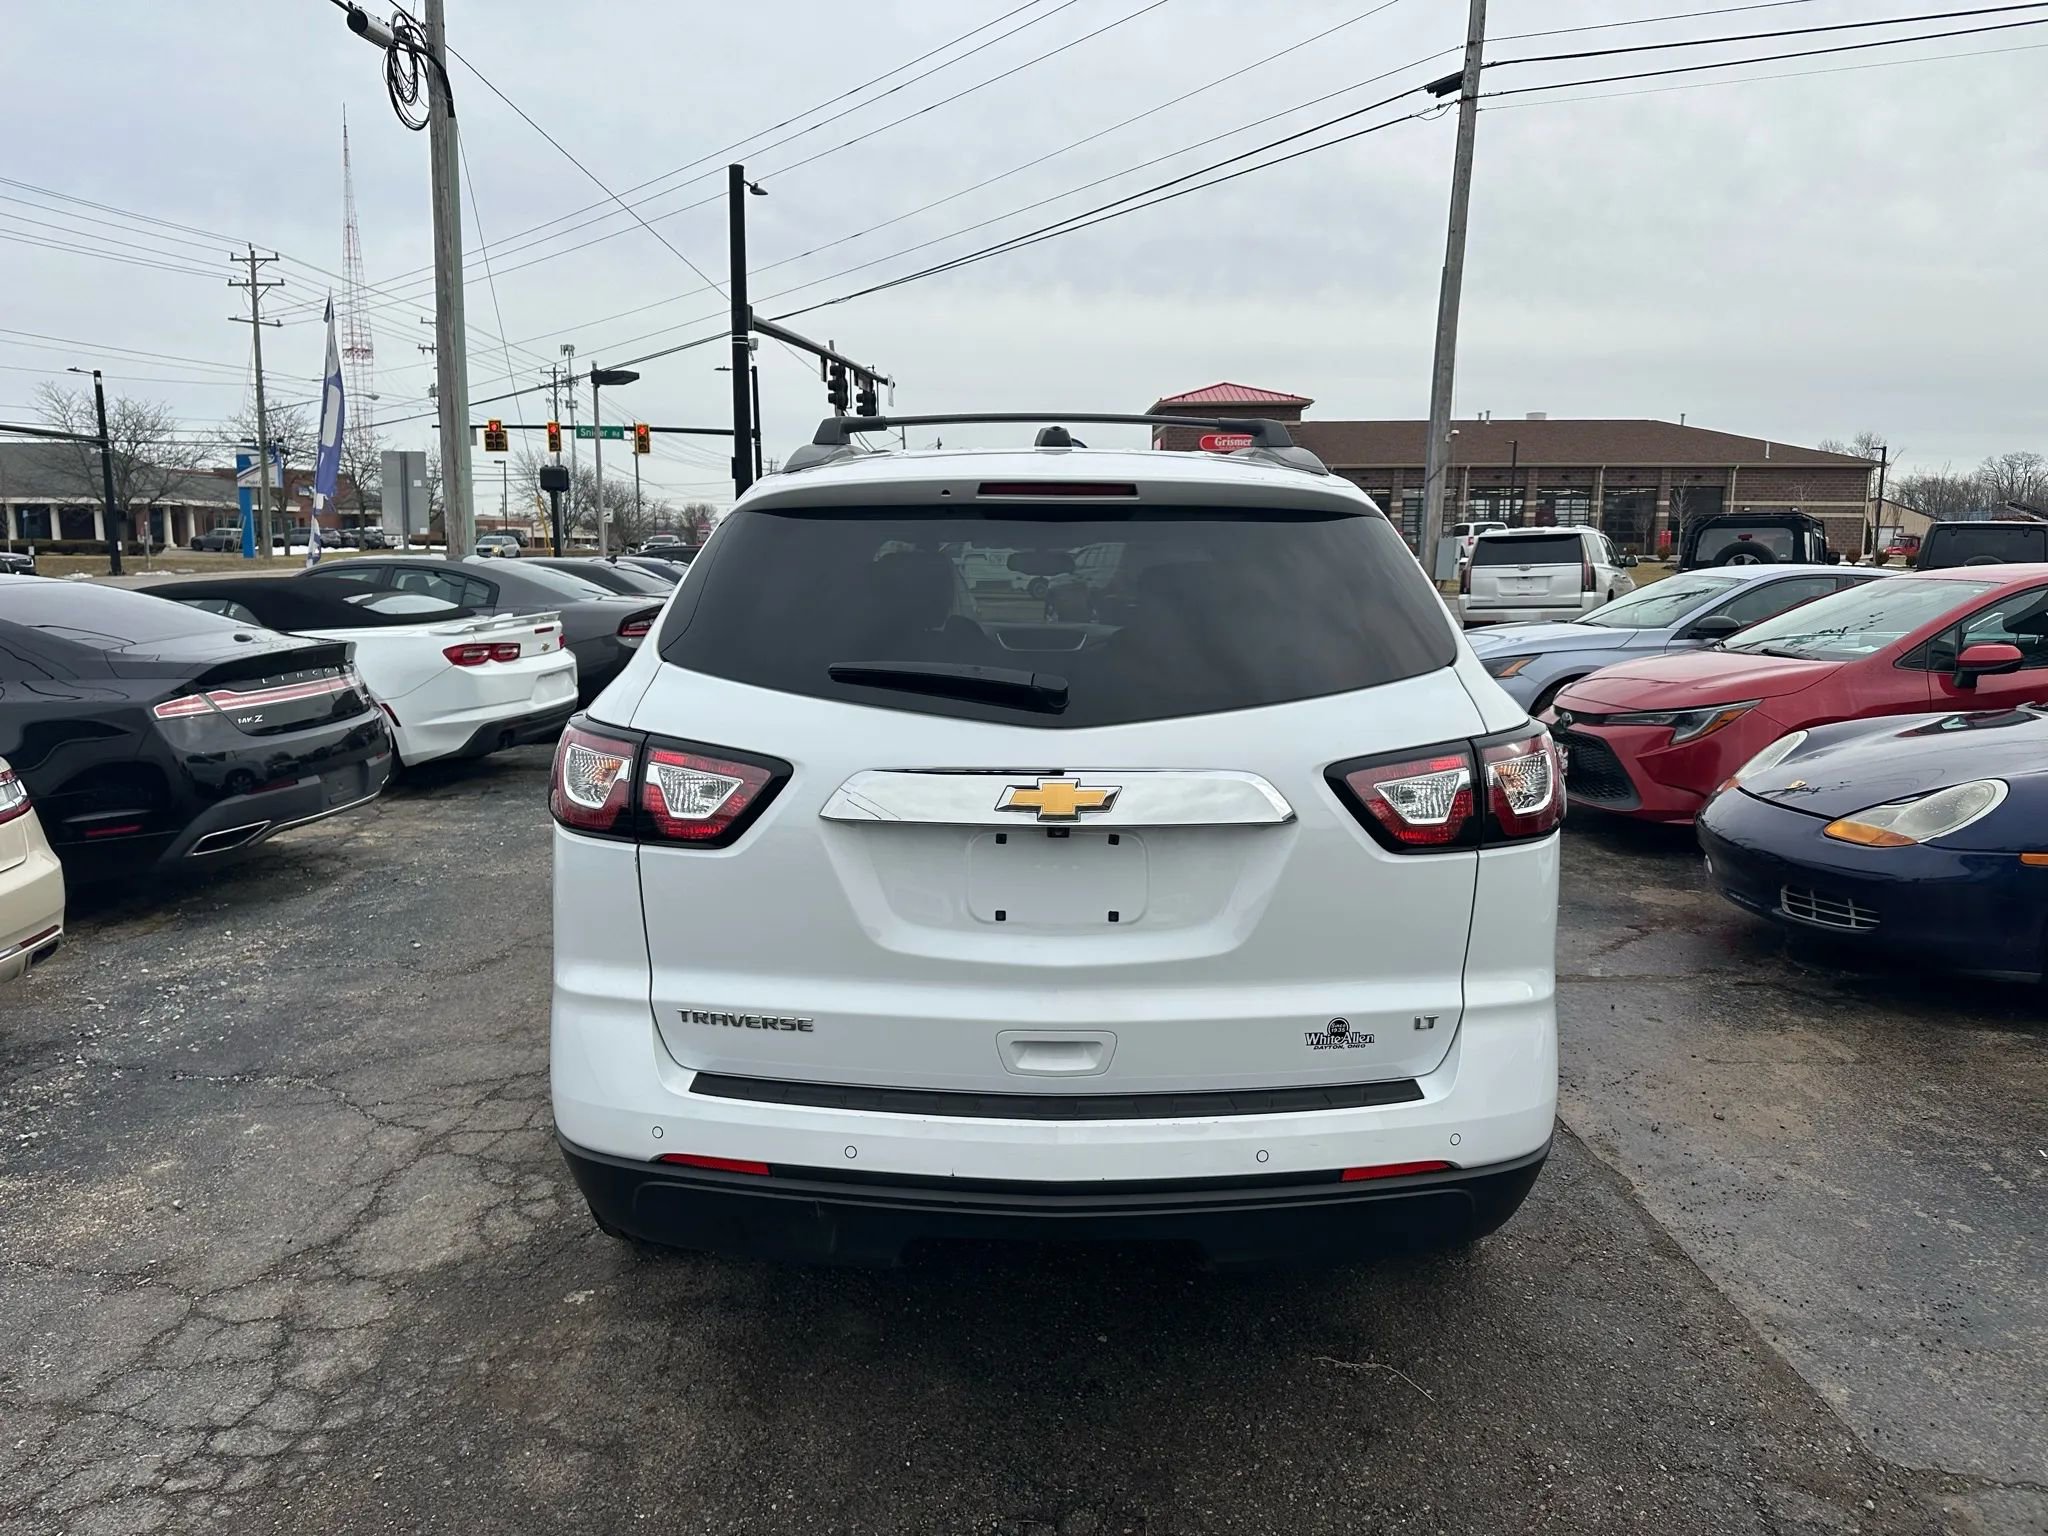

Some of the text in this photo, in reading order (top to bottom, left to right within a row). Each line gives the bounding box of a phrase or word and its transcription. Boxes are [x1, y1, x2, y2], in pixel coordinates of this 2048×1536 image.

[580, 428, 608, 437] Snier
[1214, 437, 1252, 446] Grismer
[677, 1008, 814, 1032] TRAVERSE
[1414, 1015, 1440, 1030] LT
